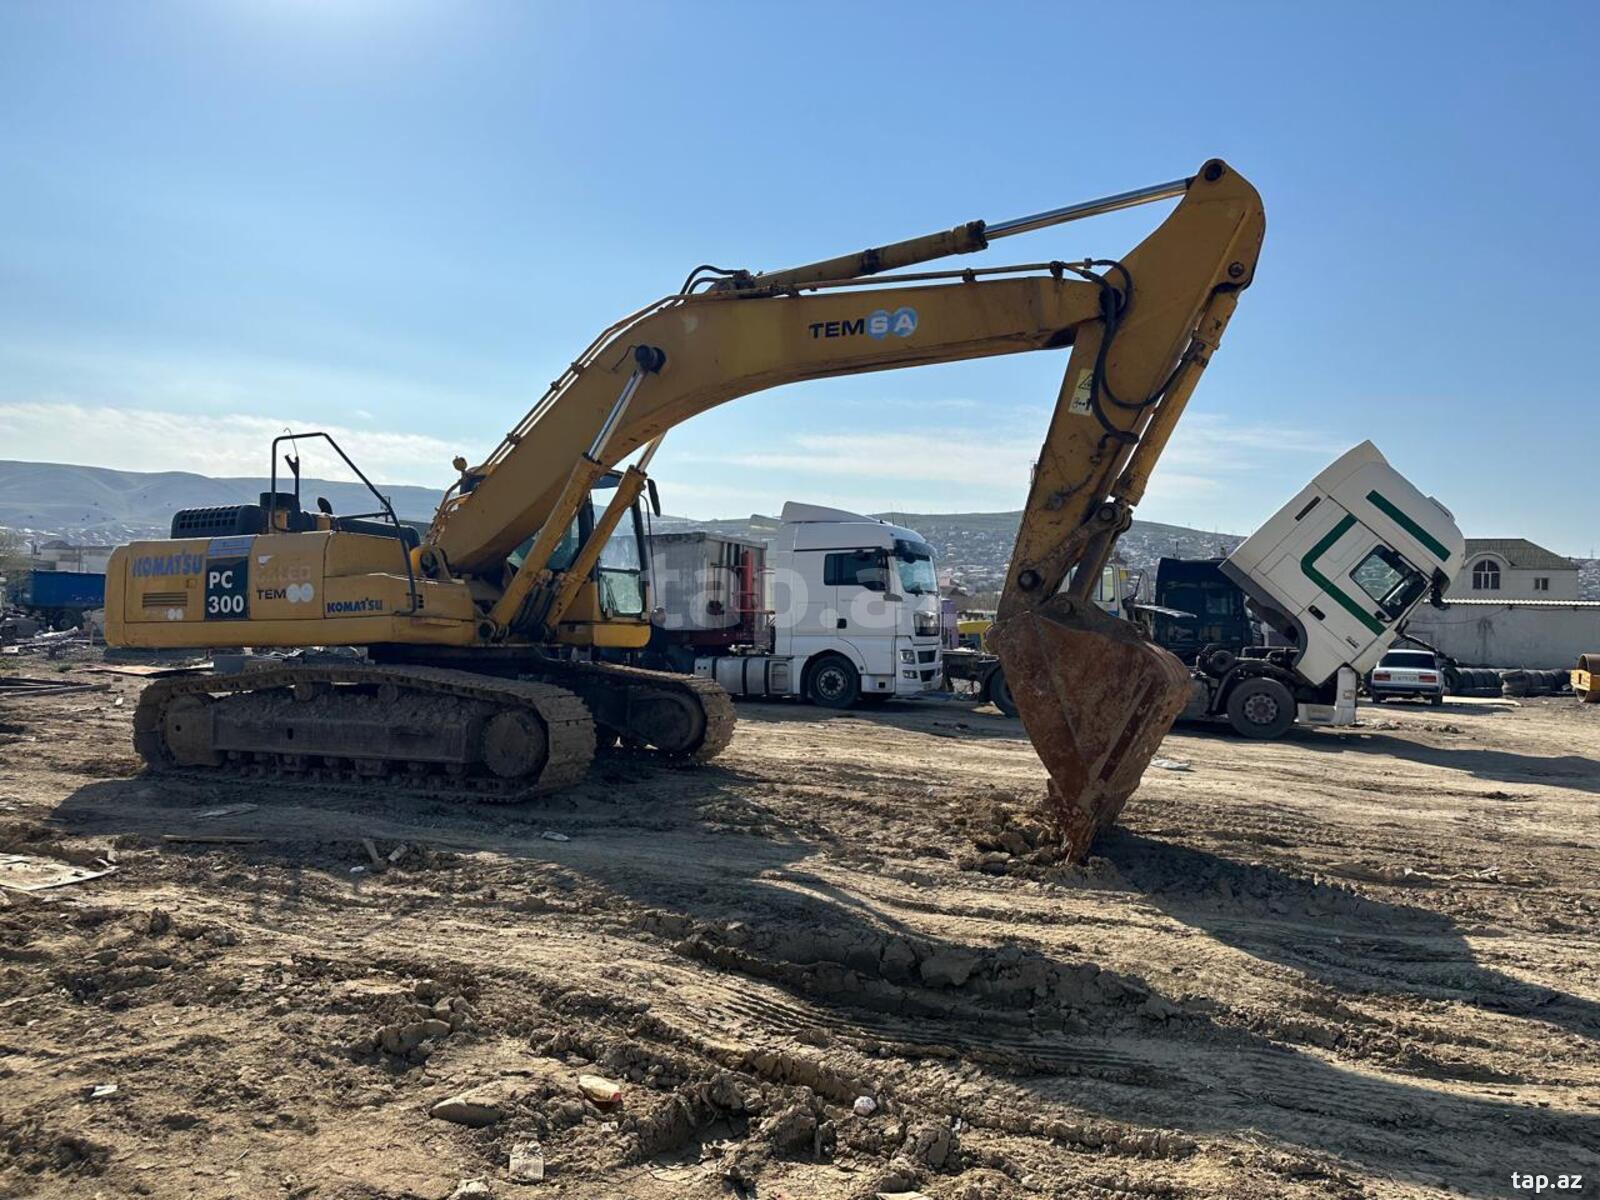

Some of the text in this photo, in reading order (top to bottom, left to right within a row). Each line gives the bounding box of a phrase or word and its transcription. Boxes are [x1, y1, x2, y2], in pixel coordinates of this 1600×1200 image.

[808, 308, 918, 340] TEMSA
[133, 551, 204, 577] KOMATSU
[209, 570, 233, 589] PC
[208, 595, 244, 613] 300
[326, 598, 383, 613] KOMATSU
